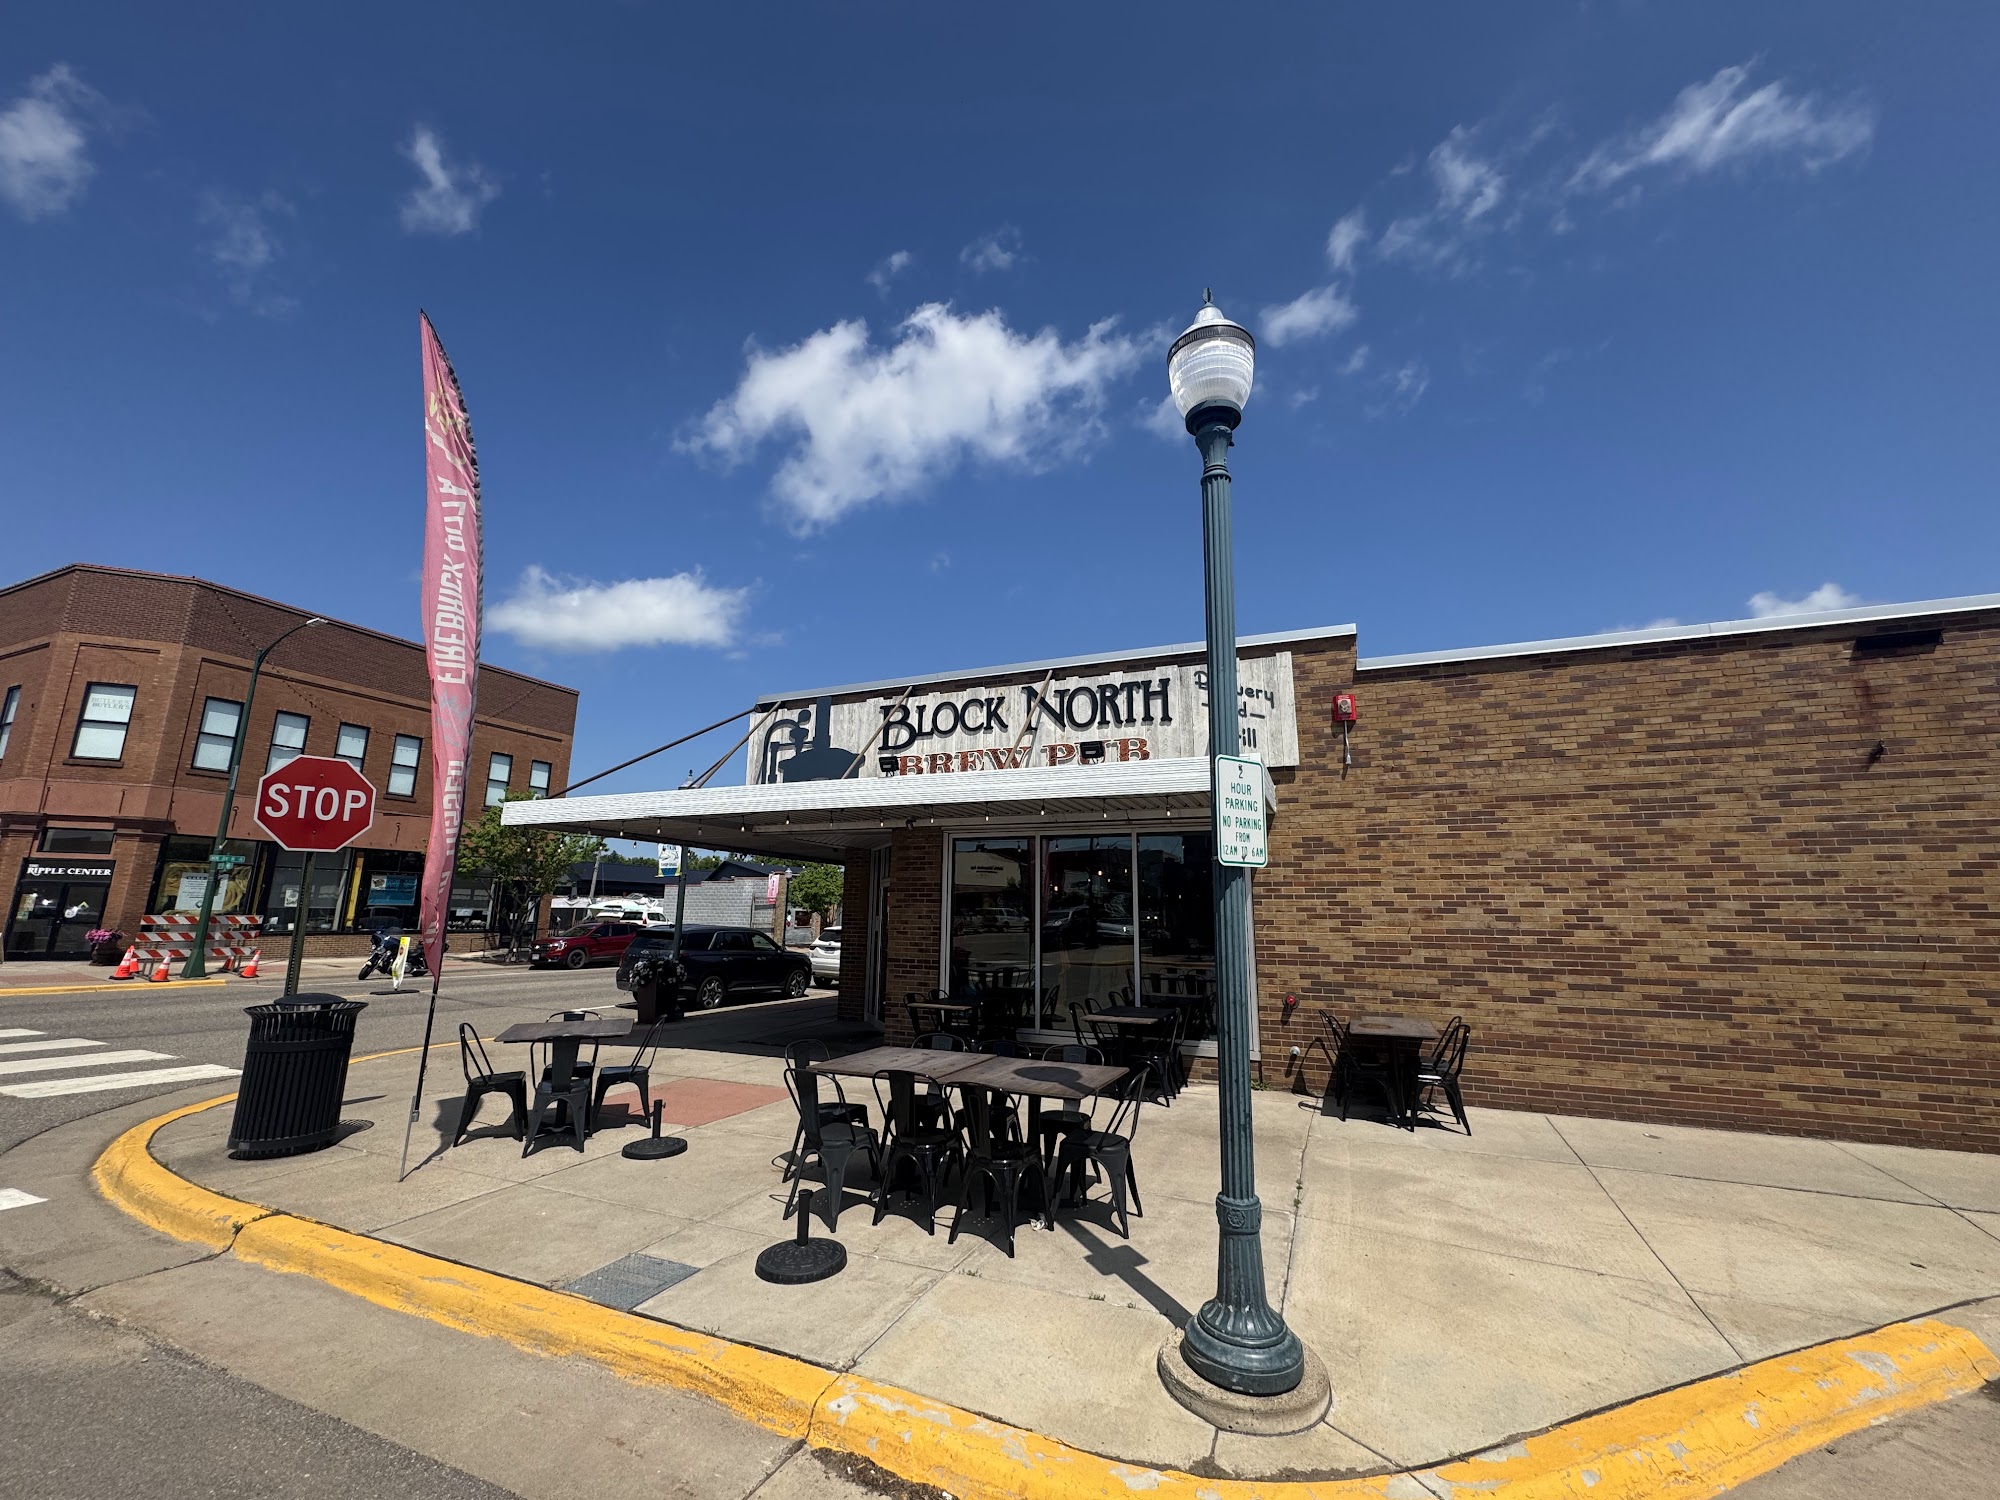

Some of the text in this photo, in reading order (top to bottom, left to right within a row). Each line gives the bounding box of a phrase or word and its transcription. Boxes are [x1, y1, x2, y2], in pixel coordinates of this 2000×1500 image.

[877, 677, 1173, 751] BLOCK NORTH
[898, 746, 1032, 776] BREW
[1230, 782, 1252, 796] HOUR
[264, 782, 367, 822] STOP
[1225, 797, 1258, 813] PARKING
[1222, 815, 1262, 831] NO PARKING
[1235, 831, 1251, 843] FROM
[1222, 844, 1264, 858] 12AM TO 6AM
[26, 867, 112, 876] RIPPLE CENTER
